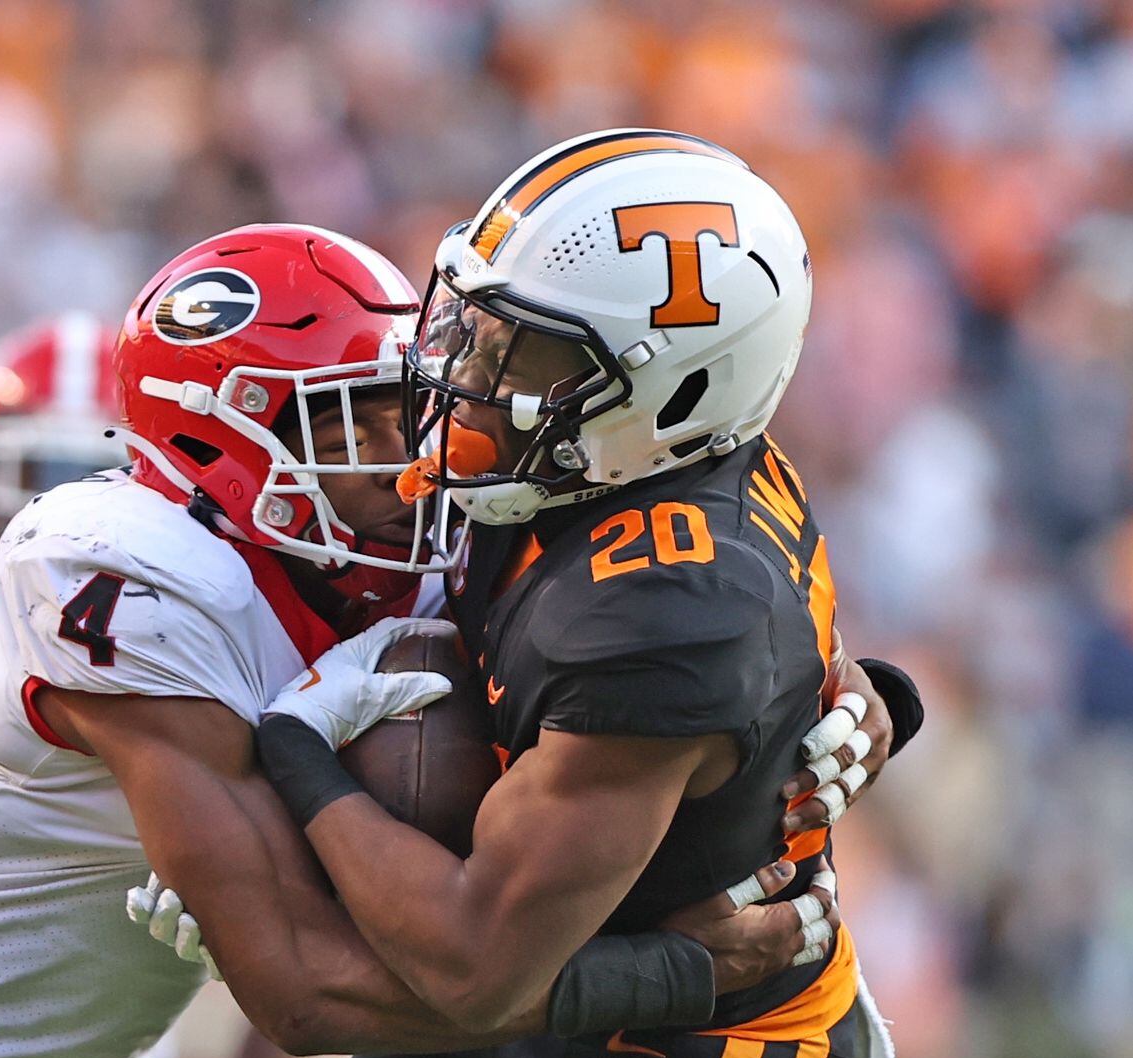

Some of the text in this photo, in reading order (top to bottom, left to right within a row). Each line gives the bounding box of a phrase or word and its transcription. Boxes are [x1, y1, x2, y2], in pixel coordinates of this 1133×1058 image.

[612, 201, 740, 328] T
[153, 269, 259, 345] G
[573, 485, 622, 502] SPOR
[590, 502, 715, 583] 20
[58, 571, 126, 667] 4
